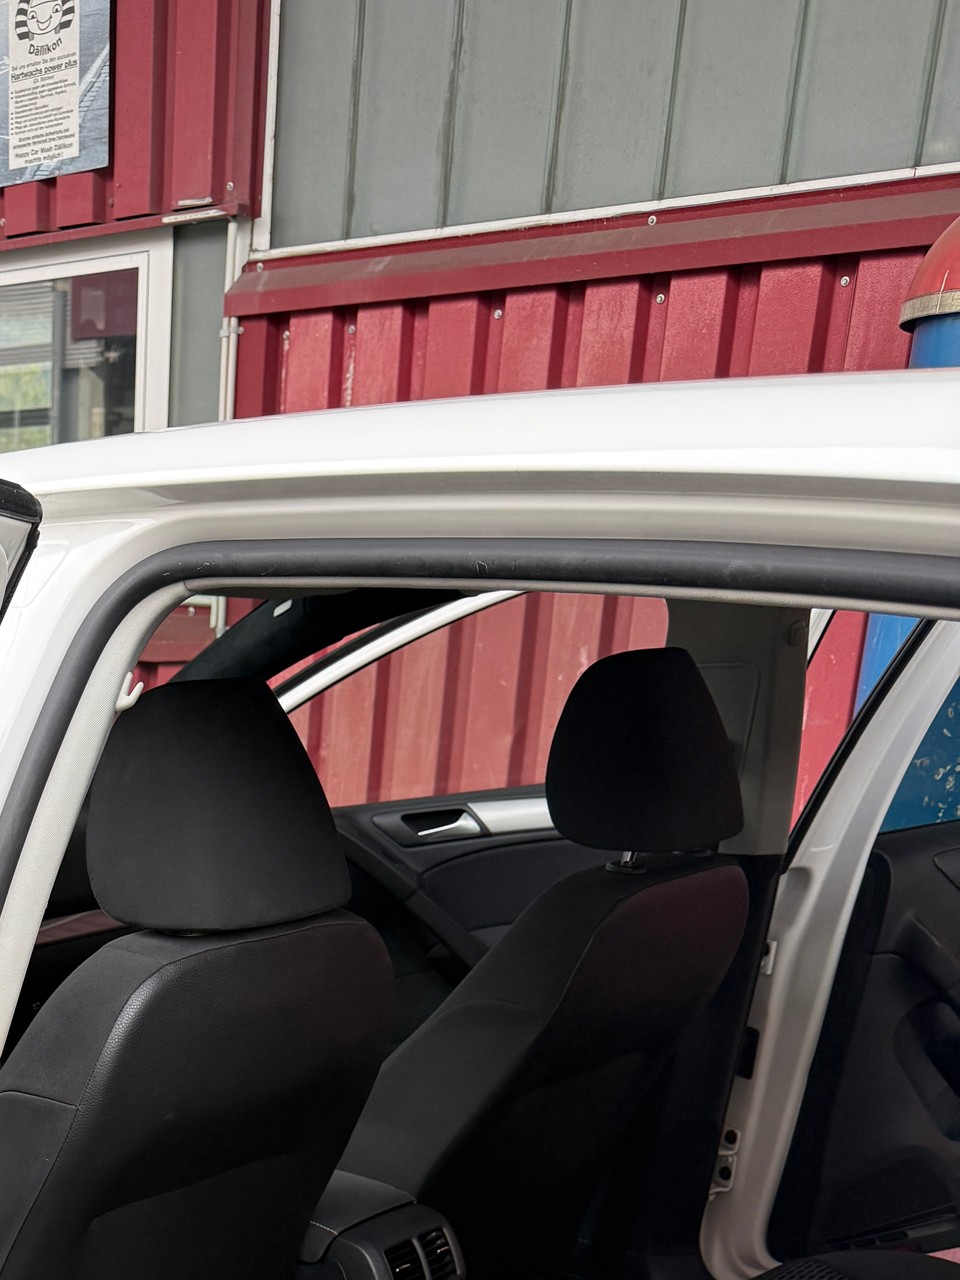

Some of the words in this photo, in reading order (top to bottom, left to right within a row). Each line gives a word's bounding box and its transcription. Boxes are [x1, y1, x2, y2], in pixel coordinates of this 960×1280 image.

[28, 37, 63, 56] Dällikon
[11, 68, 43, 81] Hartwachs
[44, 63, 63, 74] power
[65, 59, 78, 69] plus
